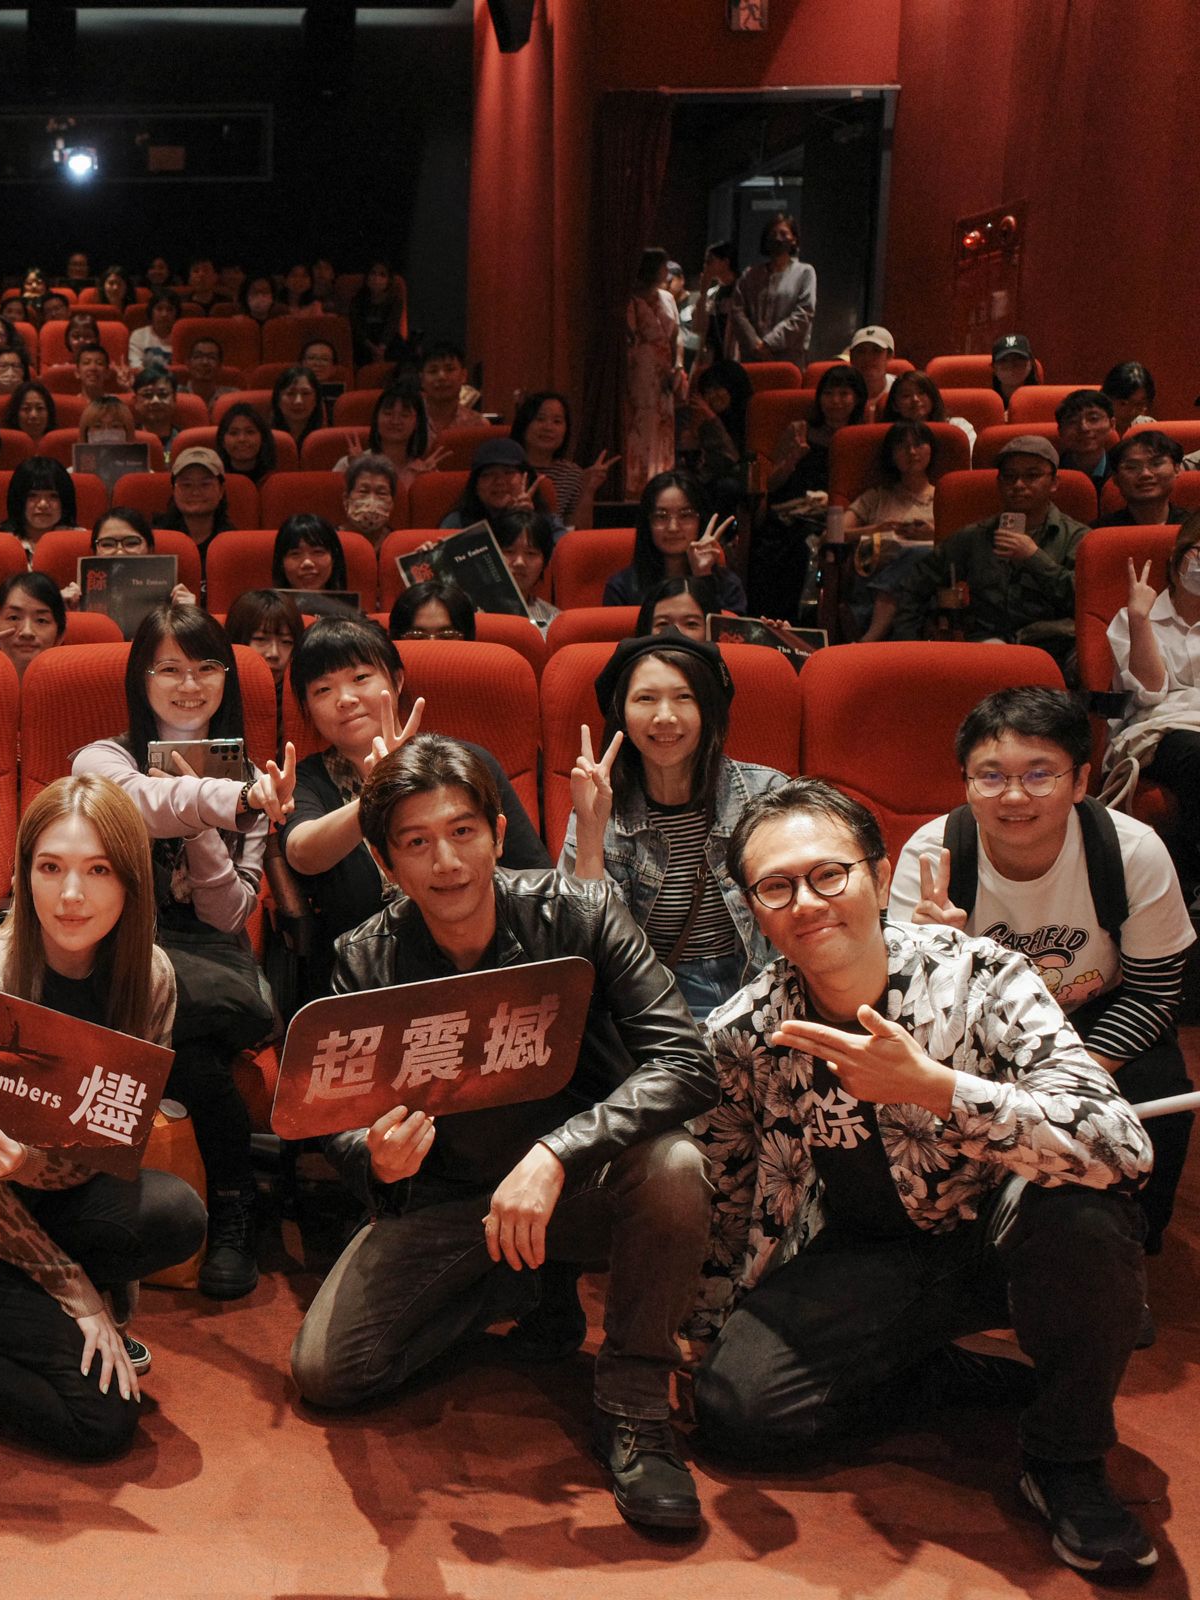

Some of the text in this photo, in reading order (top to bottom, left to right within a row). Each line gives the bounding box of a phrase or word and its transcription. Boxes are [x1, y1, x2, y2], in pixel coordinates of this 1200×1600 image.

[777, 645, 812, 657] The Embe
[303, 993, 560, 1104] 超震撼
[69, 1064, 148, 1145] 燼
